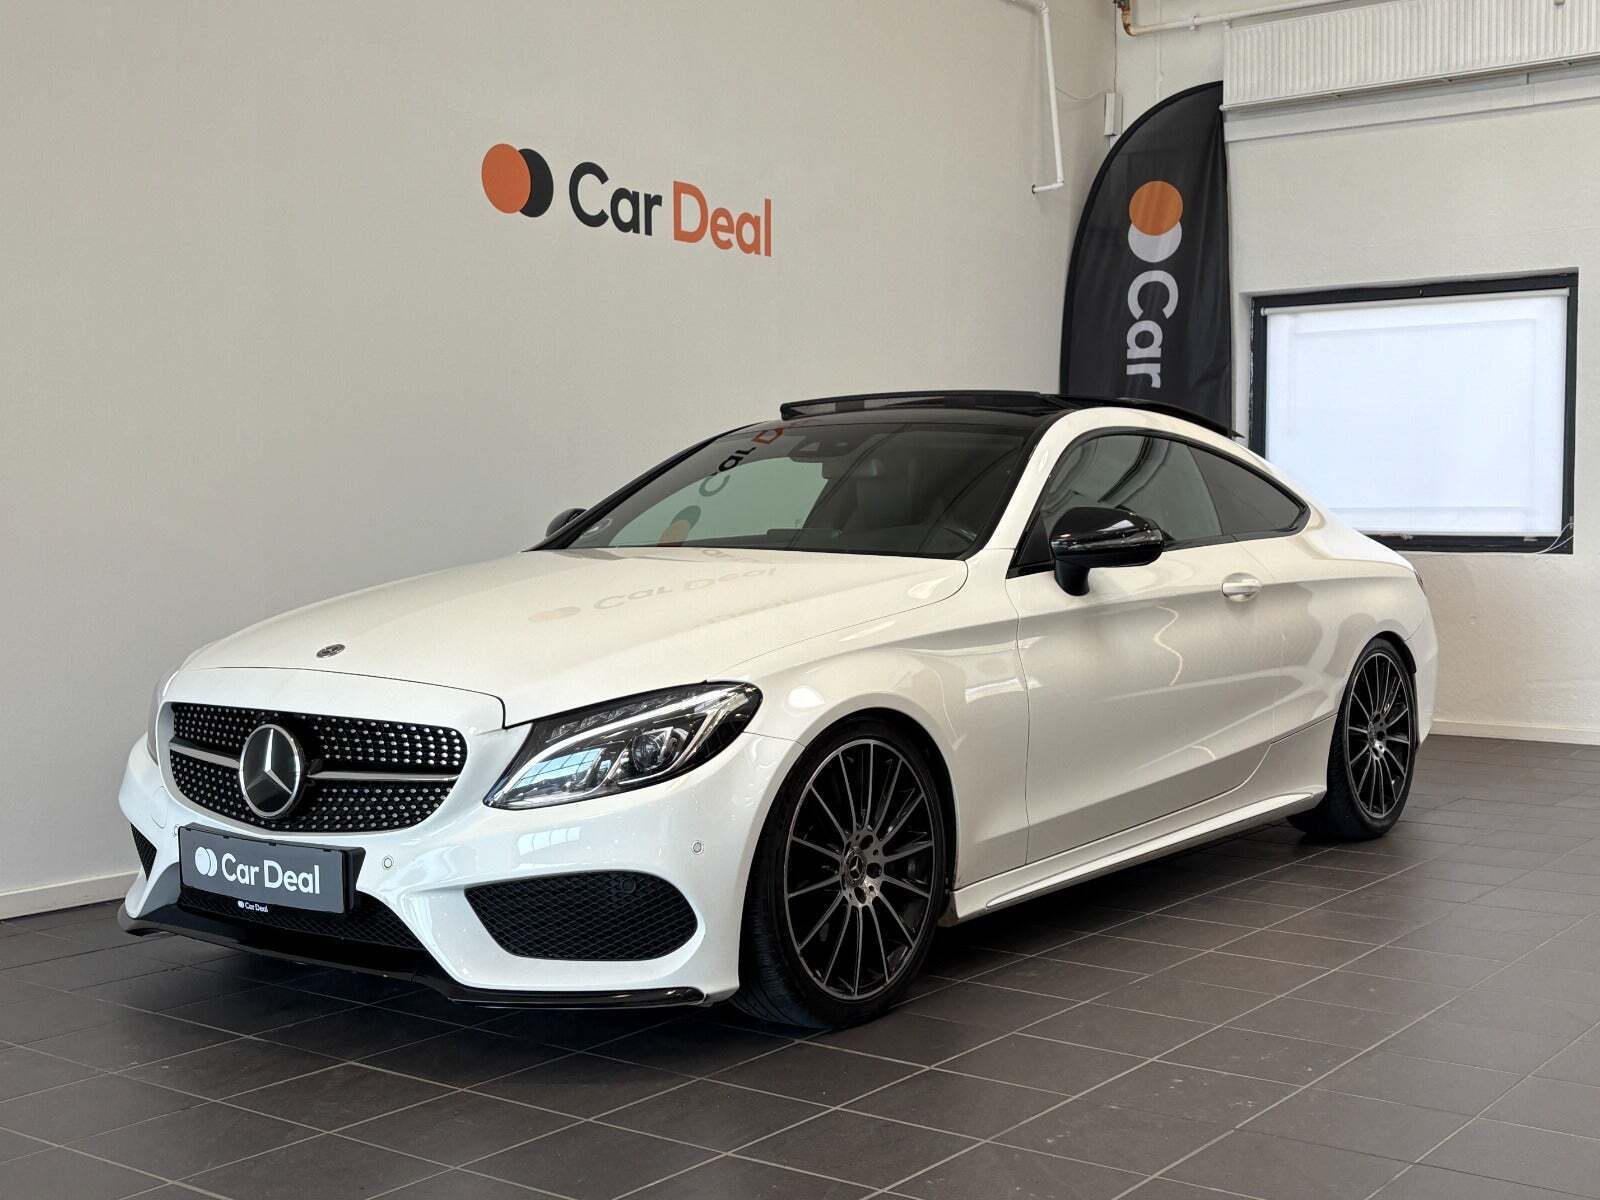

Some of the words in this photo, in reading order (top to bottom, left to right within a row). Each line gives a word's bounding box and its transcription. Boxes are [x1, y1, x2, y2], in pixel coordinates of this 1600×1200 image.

[569, 161, 662, 236] Car
[673, 180, 772, 257] Deal
[1126, 269, 1179, 389] Car
[221, 852, 260, 886] Car
[263, 859, 321, 895] Deal
[245, 901, 255, 911] Car
